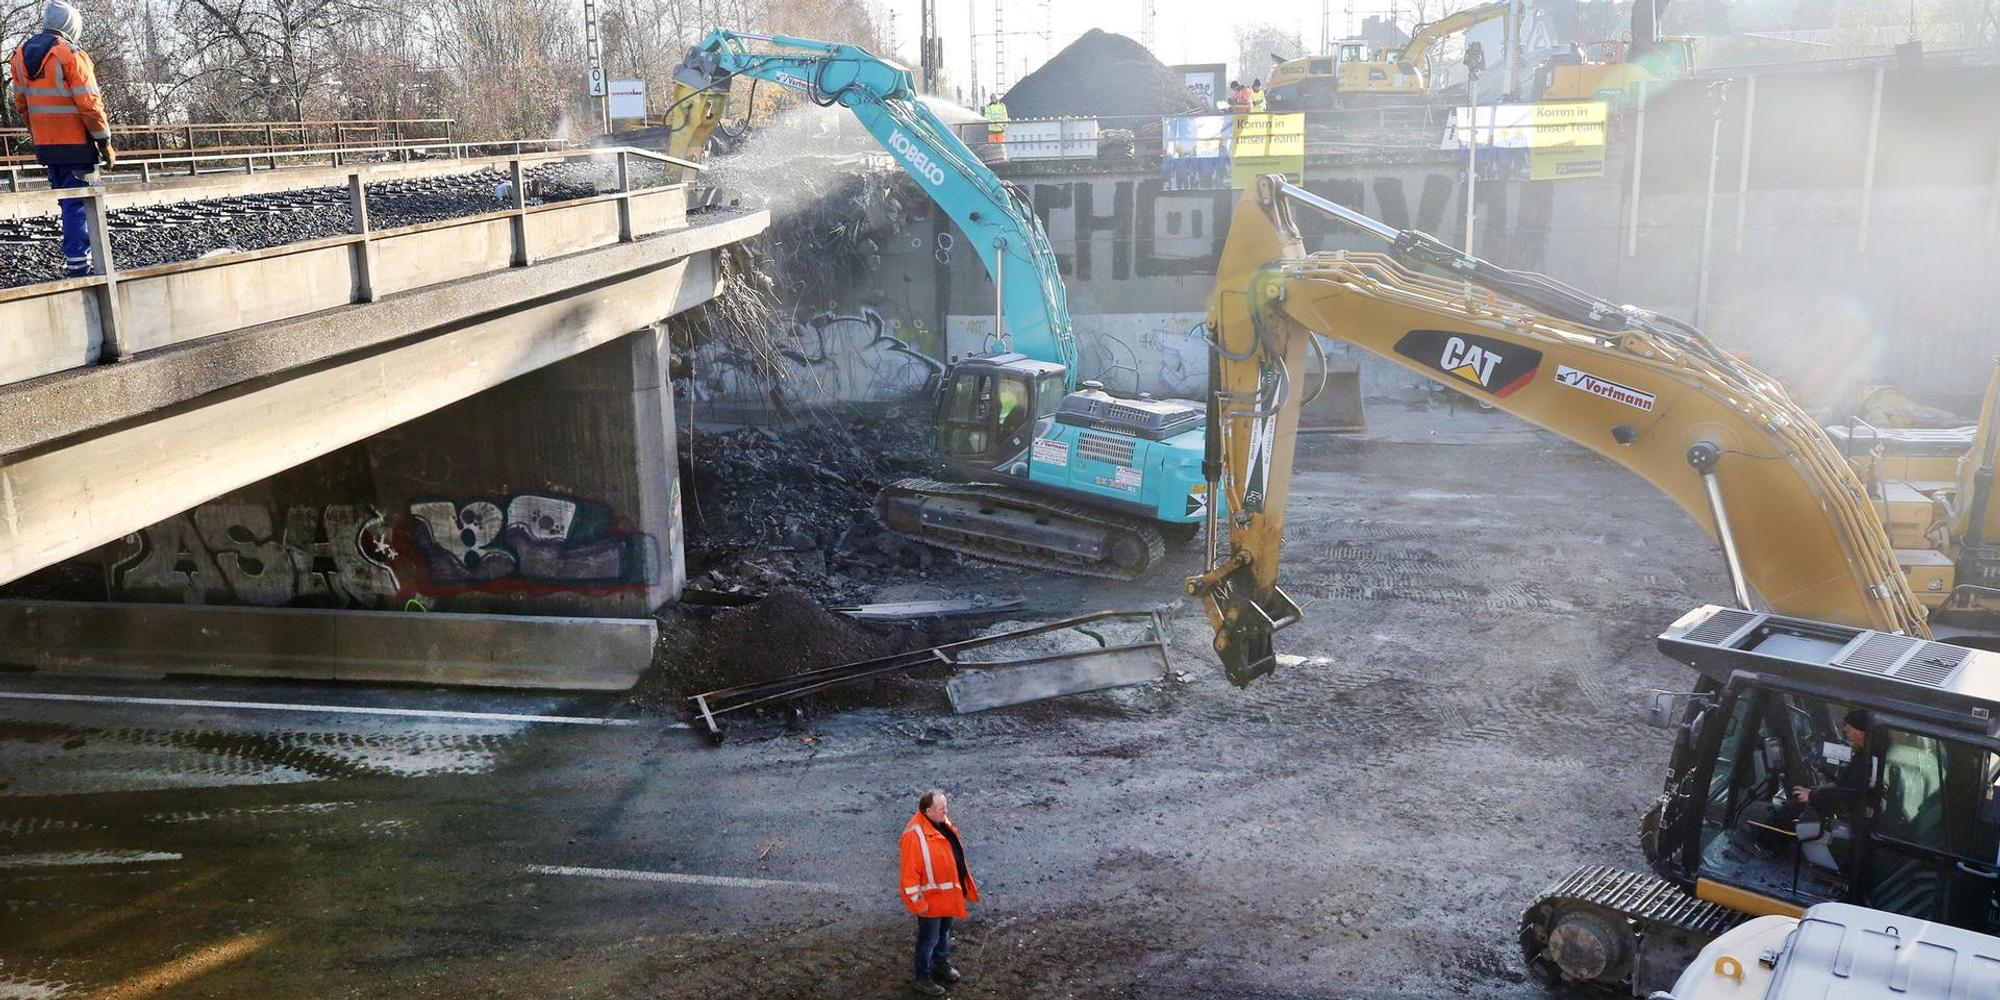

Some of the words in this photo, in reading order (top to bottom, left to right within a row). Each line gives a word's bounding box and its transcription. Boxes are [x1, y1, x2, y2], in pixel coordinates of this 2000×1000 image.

[594, 82, 601, 93] 4
[1536, 107, 1574, 117] Komm
[1577, 106, 1588, 116] in
[1237, 119, 1272, 129] Komm
[1274, 119, 1285, 128] in
[1536, 123, 1566, 133] unser
[1236, 135, 1265, 145] unser
[887, 127, 945, 186] KOBELCO
[1440, 336, 1503, 388] CAT
[1585, 377, 1653, 411] Vortmann
